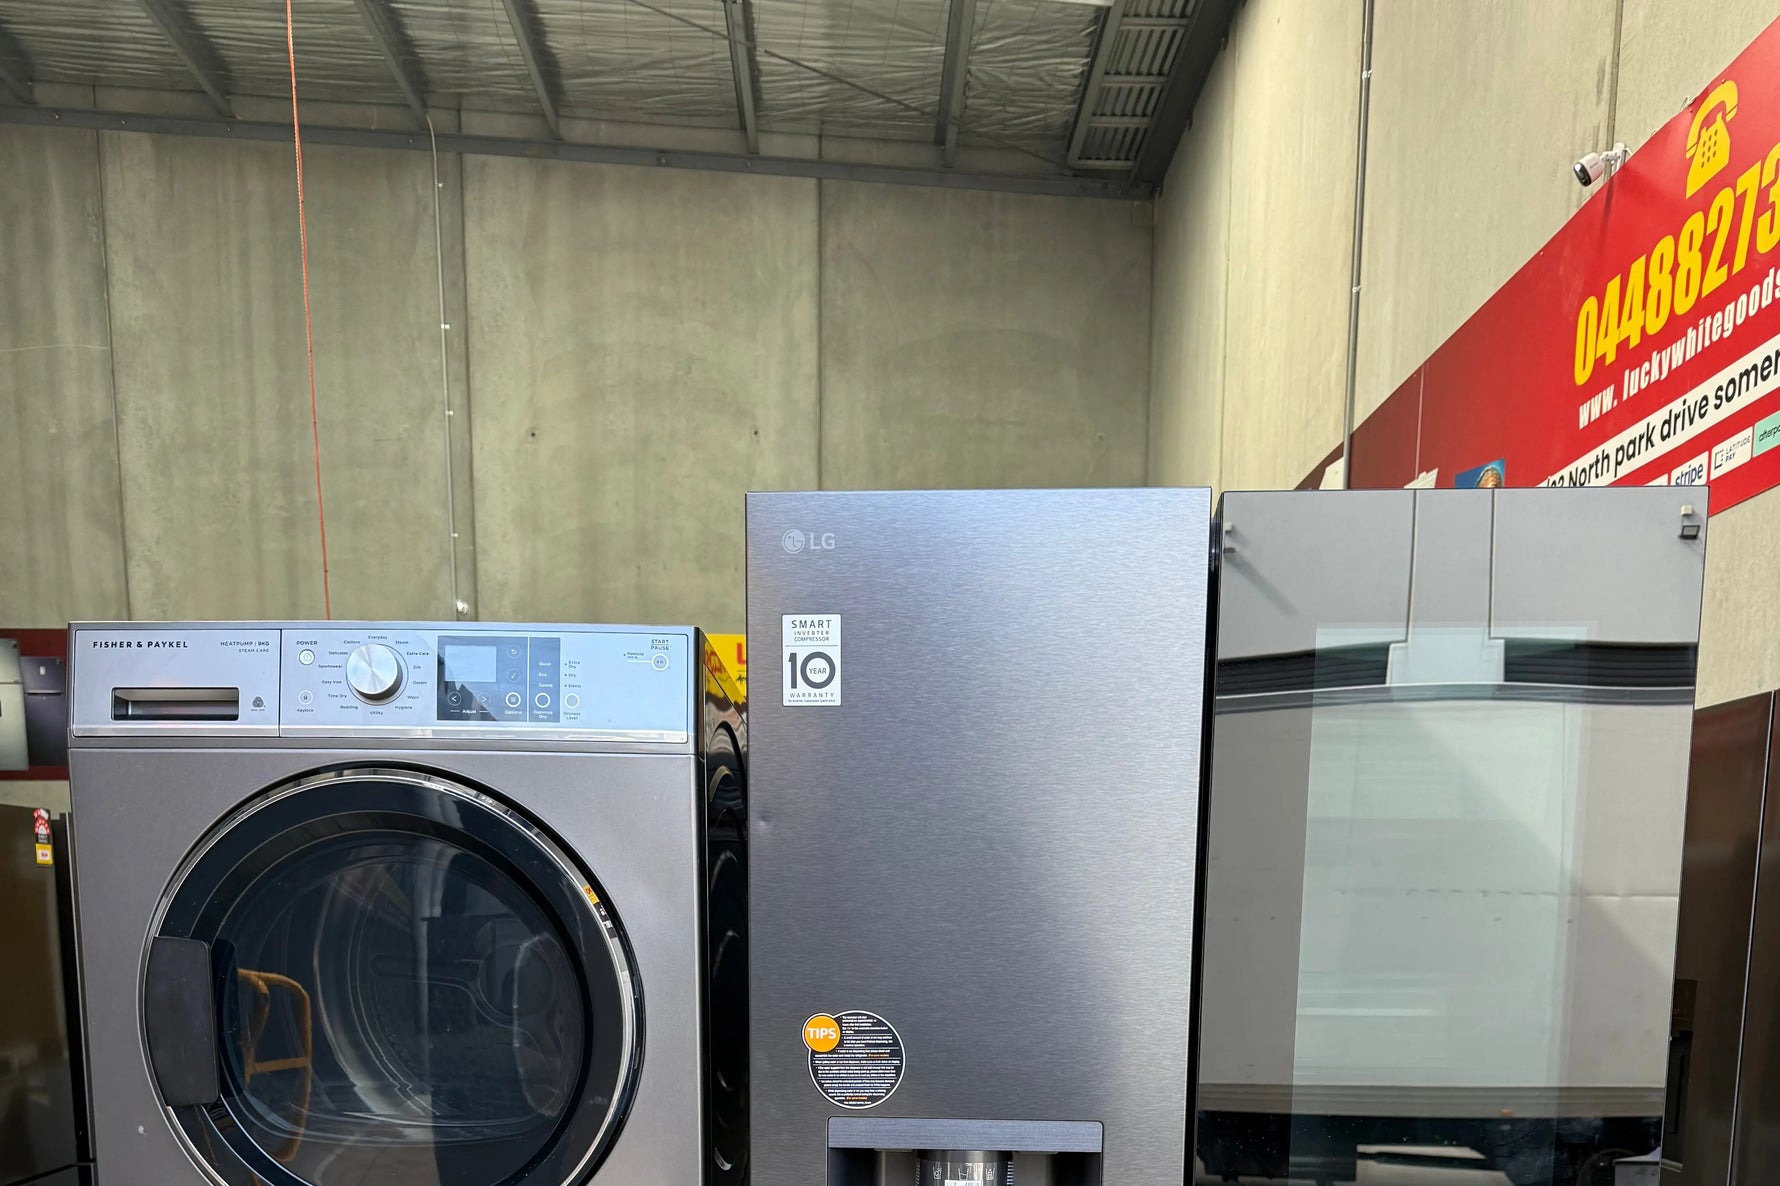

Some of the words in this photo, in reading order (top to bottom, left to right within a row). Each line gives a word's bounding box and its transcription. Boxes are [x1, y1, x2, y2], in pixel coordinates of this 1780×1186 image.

[1574, 142, 1780, 386] 04488273
[1579, 384, 1618, 430] www.
[1568, 449, 1610, 487] North
[1614, 422, 1656, 478] park
[1660, 394, 1709, 443] drive
[1675, 464, 1703, 486] stripe
[809, 532, 835, 550] LG
[791, 620, 832, 628] SMART
[788, 651, 836, 689] 10
[807, 1028, 836, 1039] TIPS
